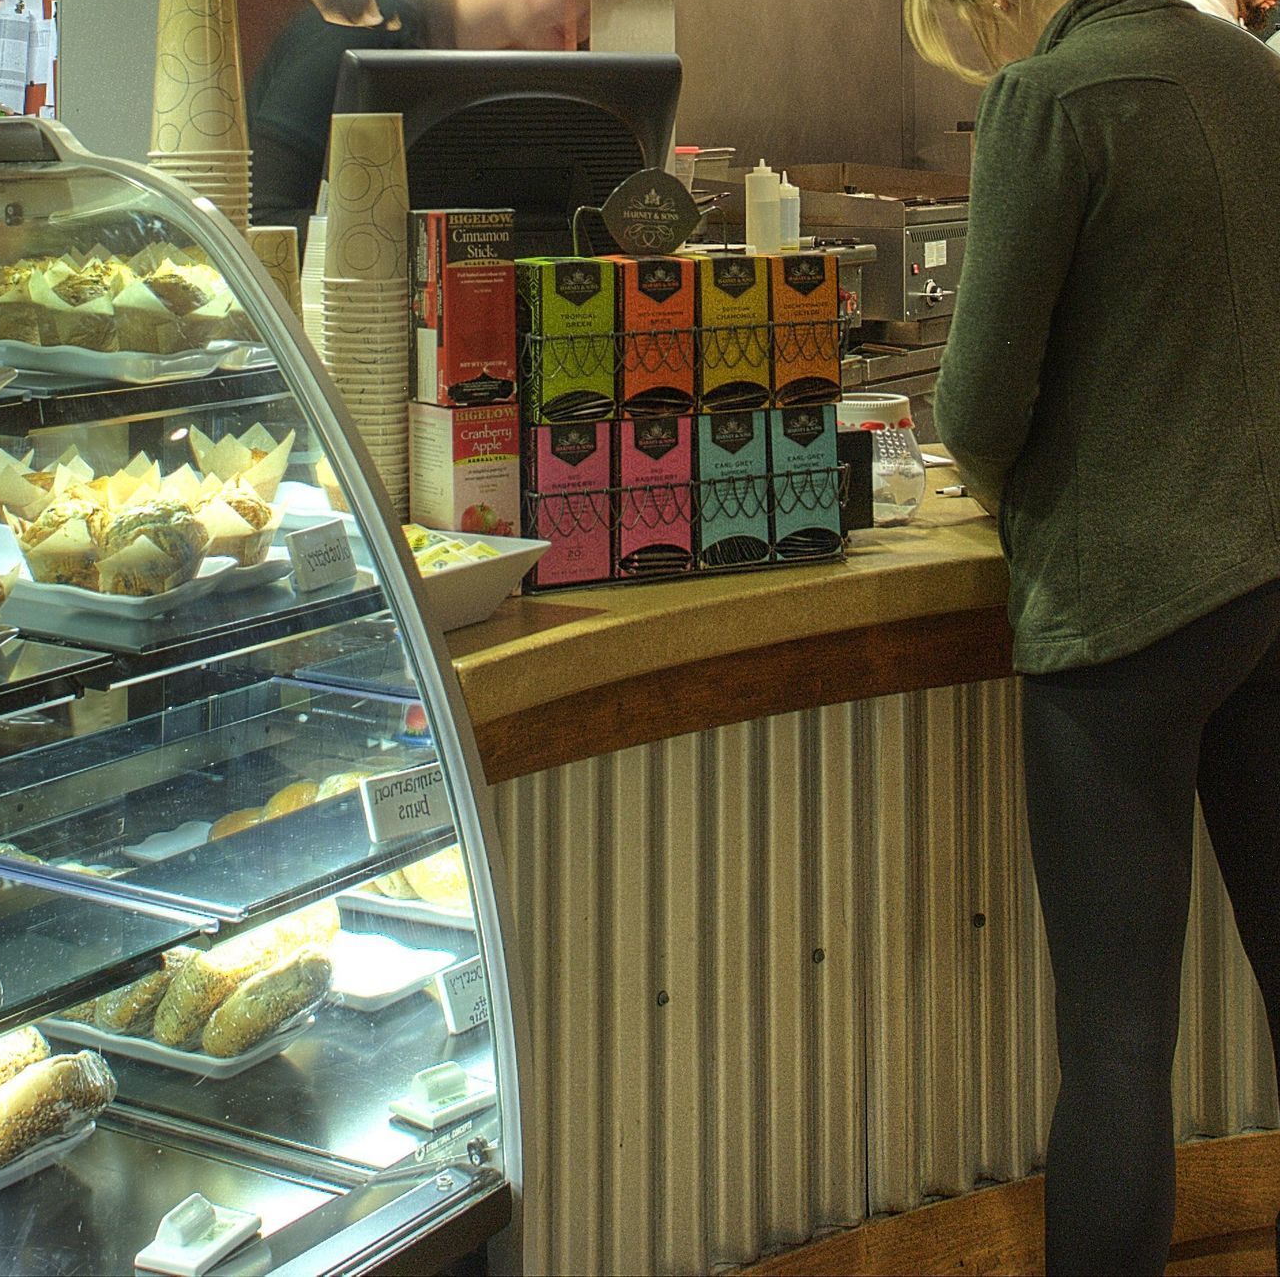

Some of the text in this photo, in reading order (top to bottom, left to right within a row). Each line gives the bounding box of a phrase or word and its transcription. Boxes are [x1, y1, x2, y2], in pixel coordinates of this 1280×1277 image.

[448, 213, 513, 224] BIGELOW
[624, 211, 653, 220] HARNEY
[661, 212, 679, 221] SONS
[452, 230, 510, 243] Cinnamon
[467, 244, 496, 258] Stick
[455, 408, 514, 421] BIGELOW
[460, 424, 511, 441] Cranberry
[472, 436, 502, 455] Apple
[806, 453, 825, 461] GREY
[714, 461, 734, 469] EARL
